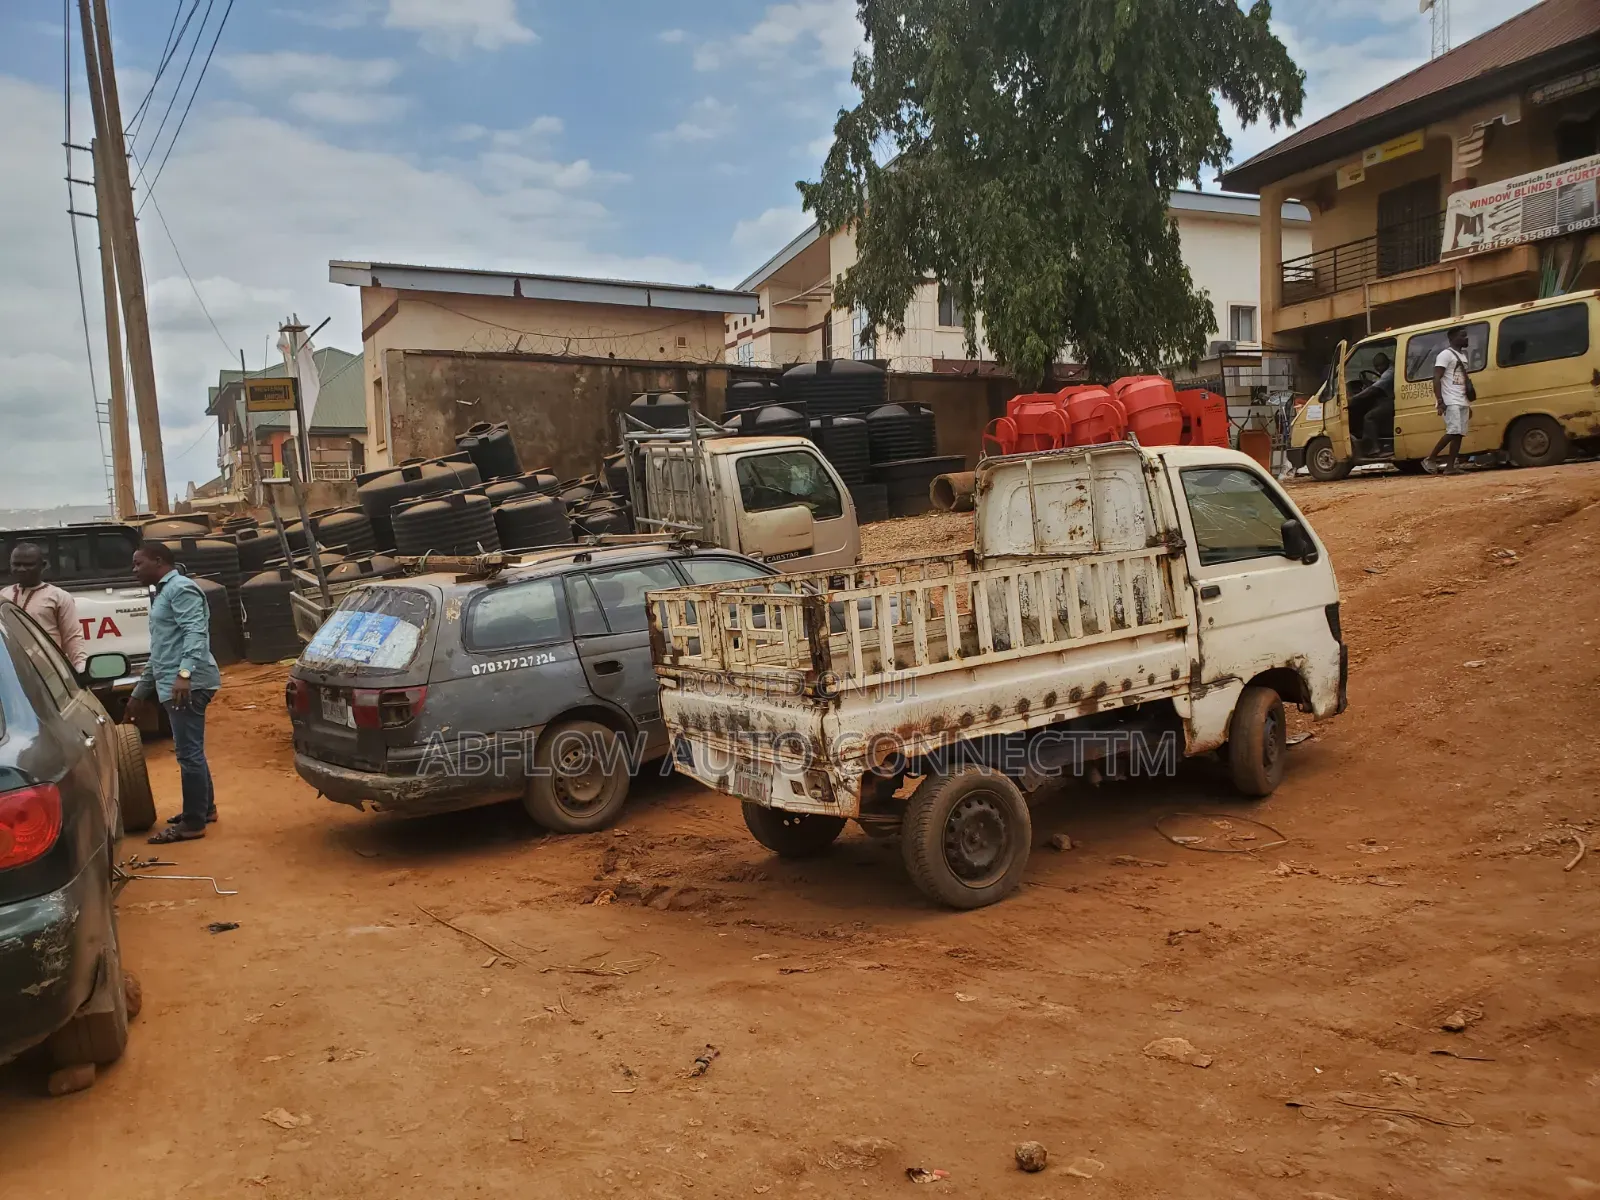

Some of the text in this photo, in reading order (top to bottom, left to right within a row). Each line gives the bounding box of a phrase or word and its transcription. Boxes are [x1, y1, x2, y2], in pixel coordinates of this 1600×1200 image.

[1506, 175, 1543, 190] Sunrich
[1545, 163, 1588, 179] Interiors
[1469, 191, 1512, 210] WINDOW
[1514, 180, 1553, 198] BLINDS
[1556, 177, 1564, 187] &
[1478, 216, 1600, 251] 08152635885 0803
[766, 551, 800, 563] CABSTAR
[472, 652, 556, 675] 07037727326
